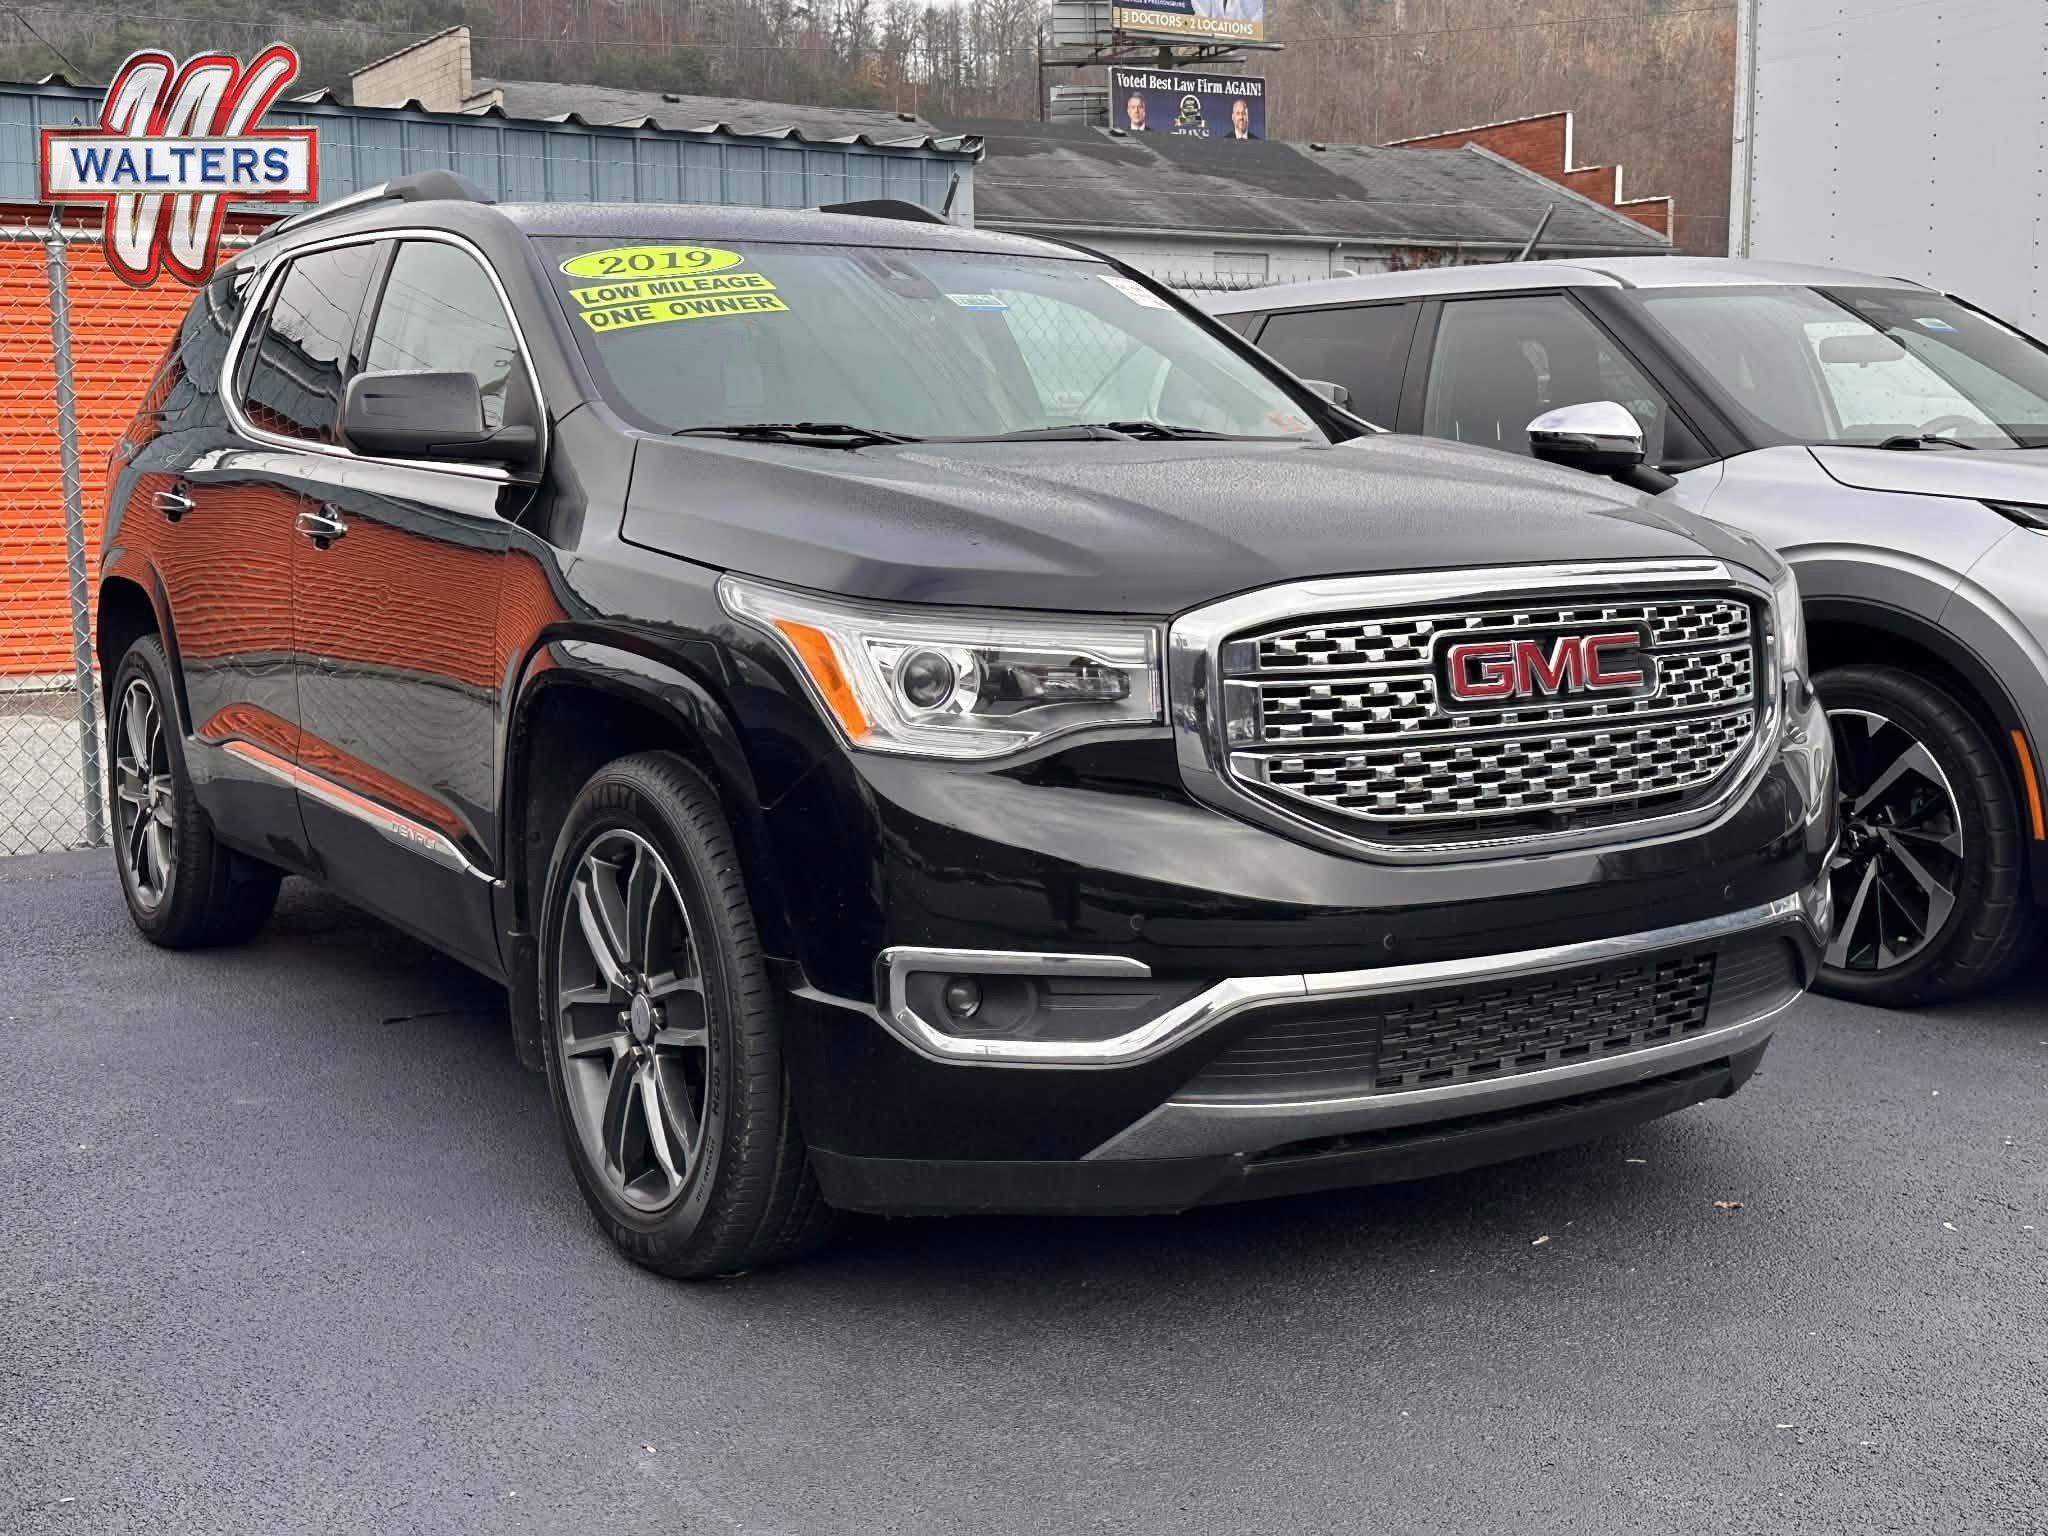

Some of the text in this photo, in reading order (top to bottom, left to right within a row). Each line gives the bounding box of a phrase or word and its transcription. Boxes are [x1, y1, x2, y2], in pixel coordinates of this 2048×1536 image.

[1123, 11, 1253, 34] 3 DOCTORS 2 LOCATIONS
[1117, 72, 1262, 97] Voted Best Law Firm AGAIN!
[598, 250, 713, 275] 2019
[581, 275, 766, 304] LOW MILEAGE
[589, 295, 781, 328] ONE OWNER
[1447, 631, 1645, 702] GMC
